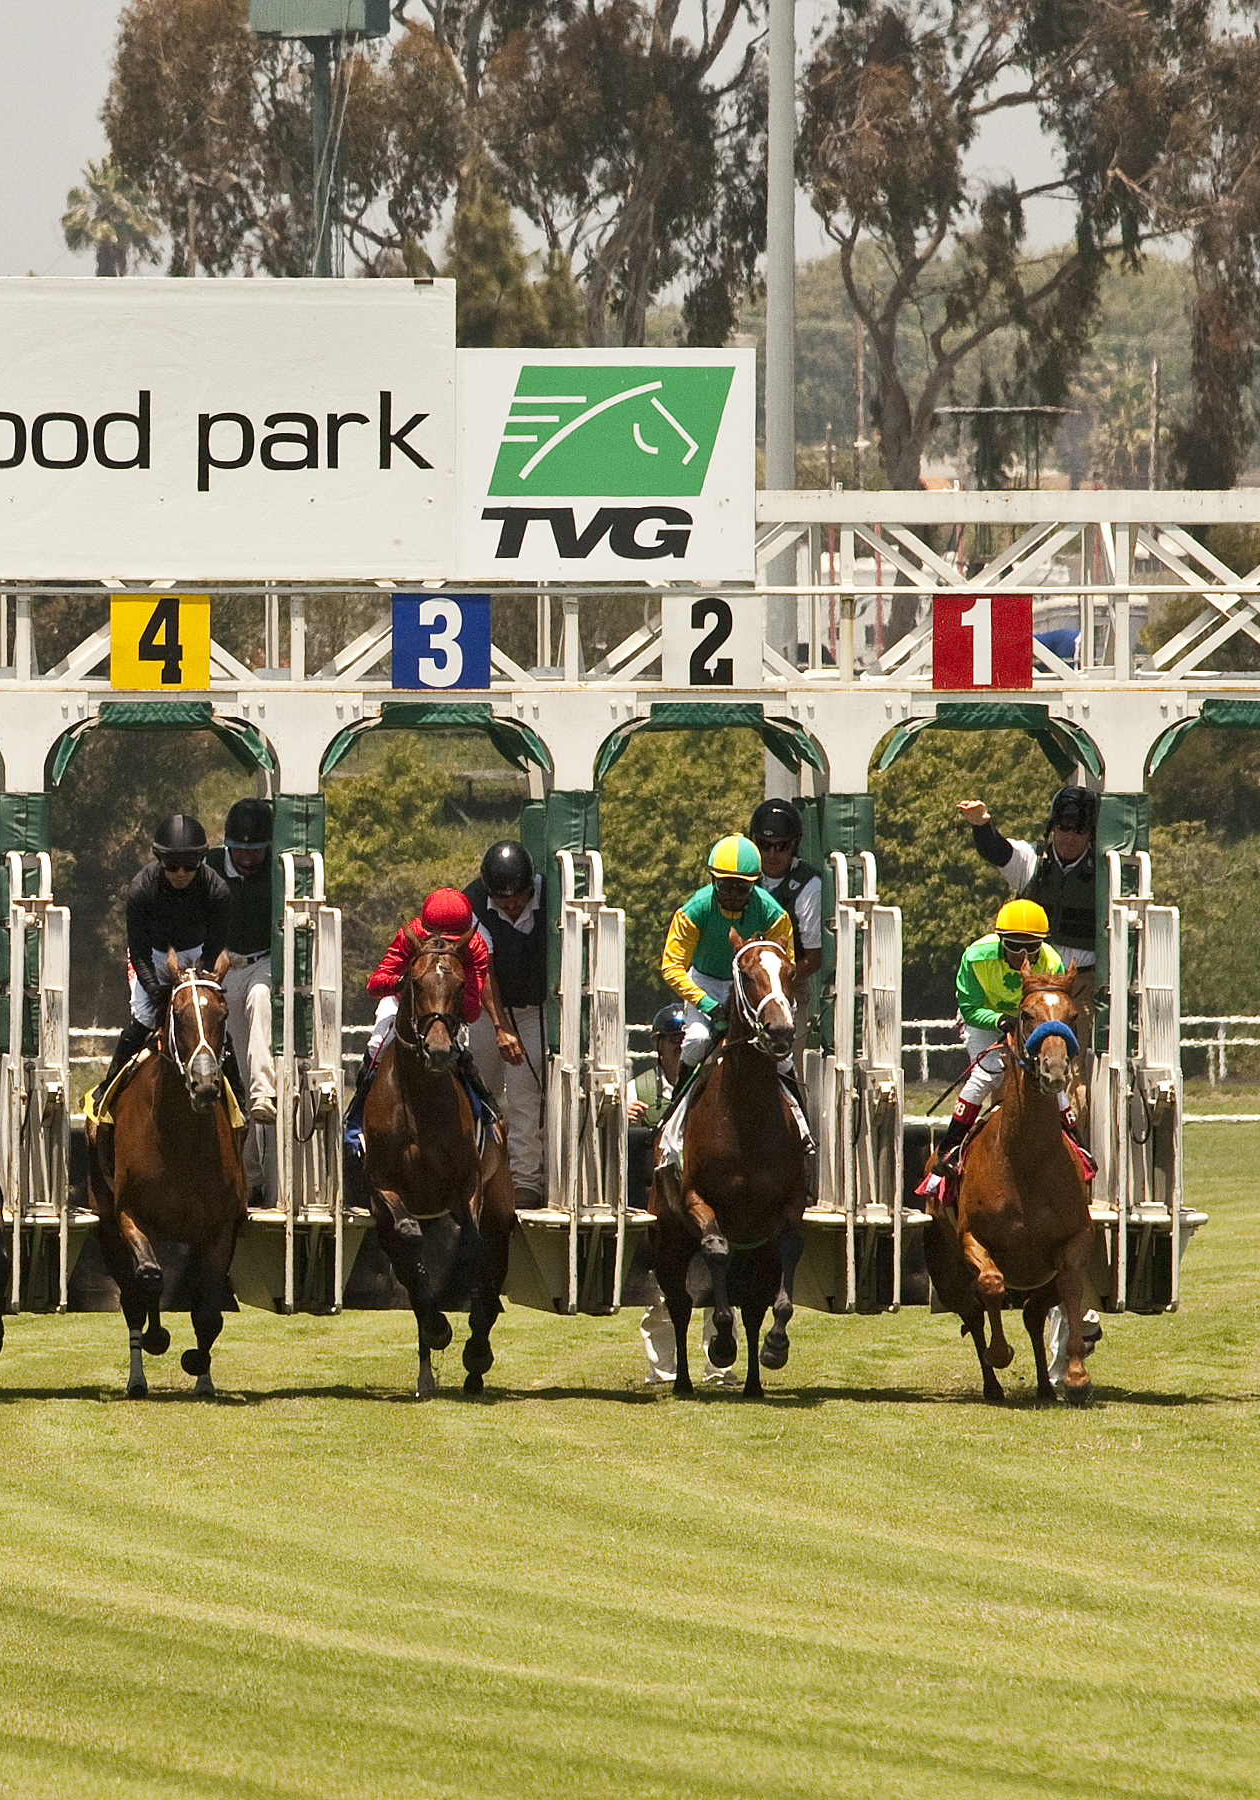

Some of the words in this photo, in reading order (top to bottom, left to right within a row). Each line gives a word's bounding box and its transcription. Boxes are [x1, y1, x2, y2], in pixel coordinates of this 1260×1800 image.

[197, 390, 434, 492] park
[480, 506, 694, 560] TVG
[138, 597, 183, 685] 4
[418, 597, 463, 688] 3
[689, 597, 734, 686] 2
[960, 598, 993, 686] 1
